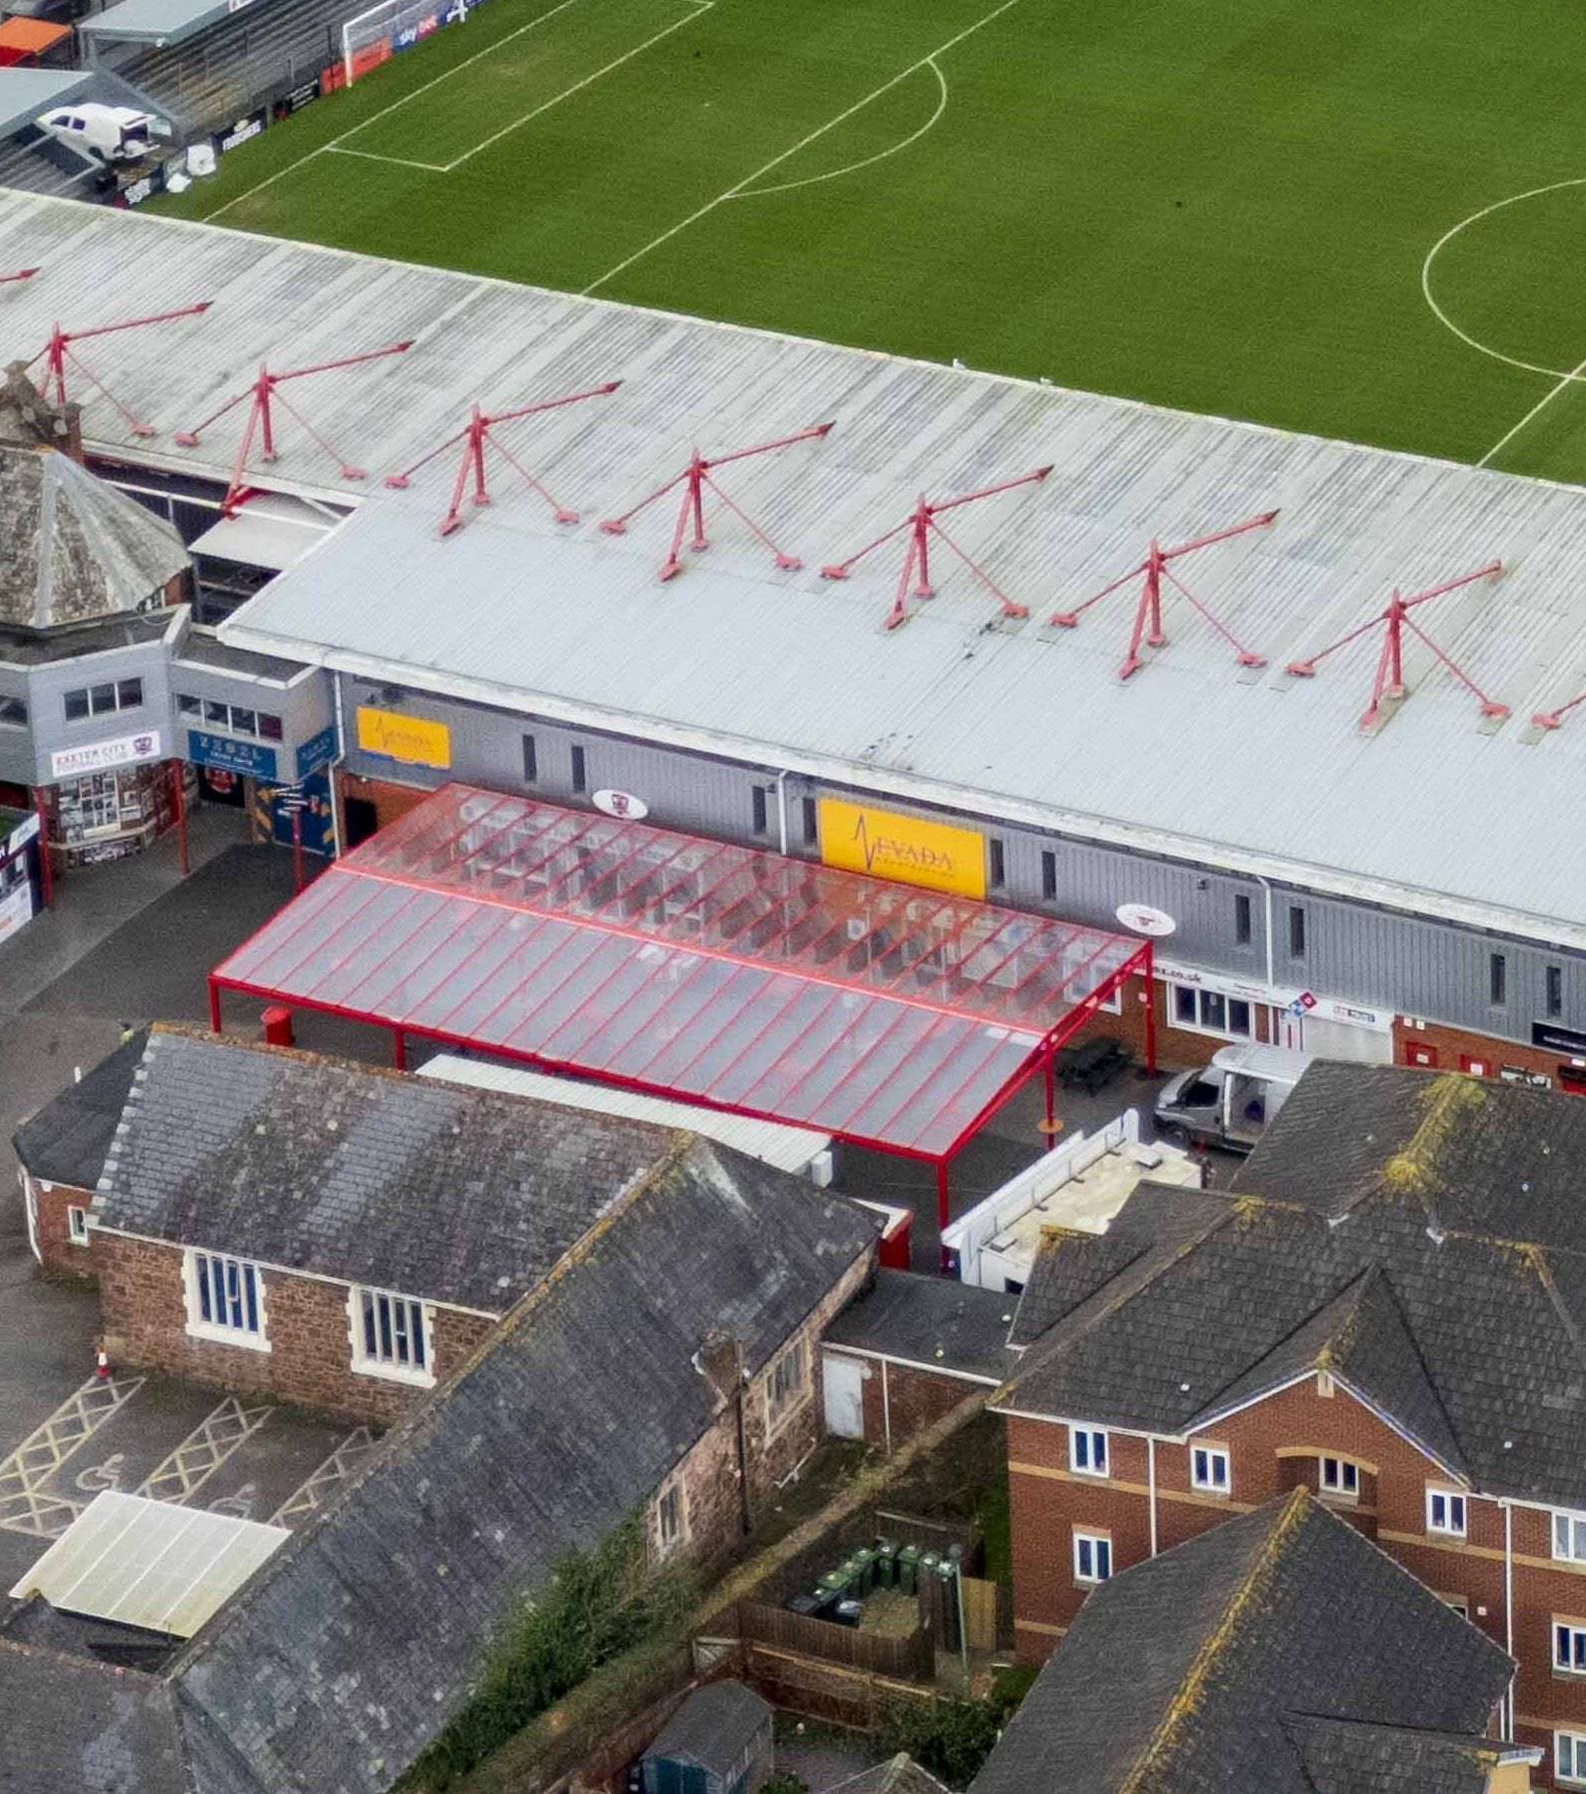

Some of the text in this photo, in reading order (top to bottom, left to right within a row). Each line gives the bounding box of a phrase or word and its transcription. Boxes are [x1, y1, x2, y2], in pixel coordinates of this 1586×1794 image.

[57, 750, 99, 765] EXETER
[102, 744, 126, 756] CITY
[850, 813, 953, 871] NEVADA
